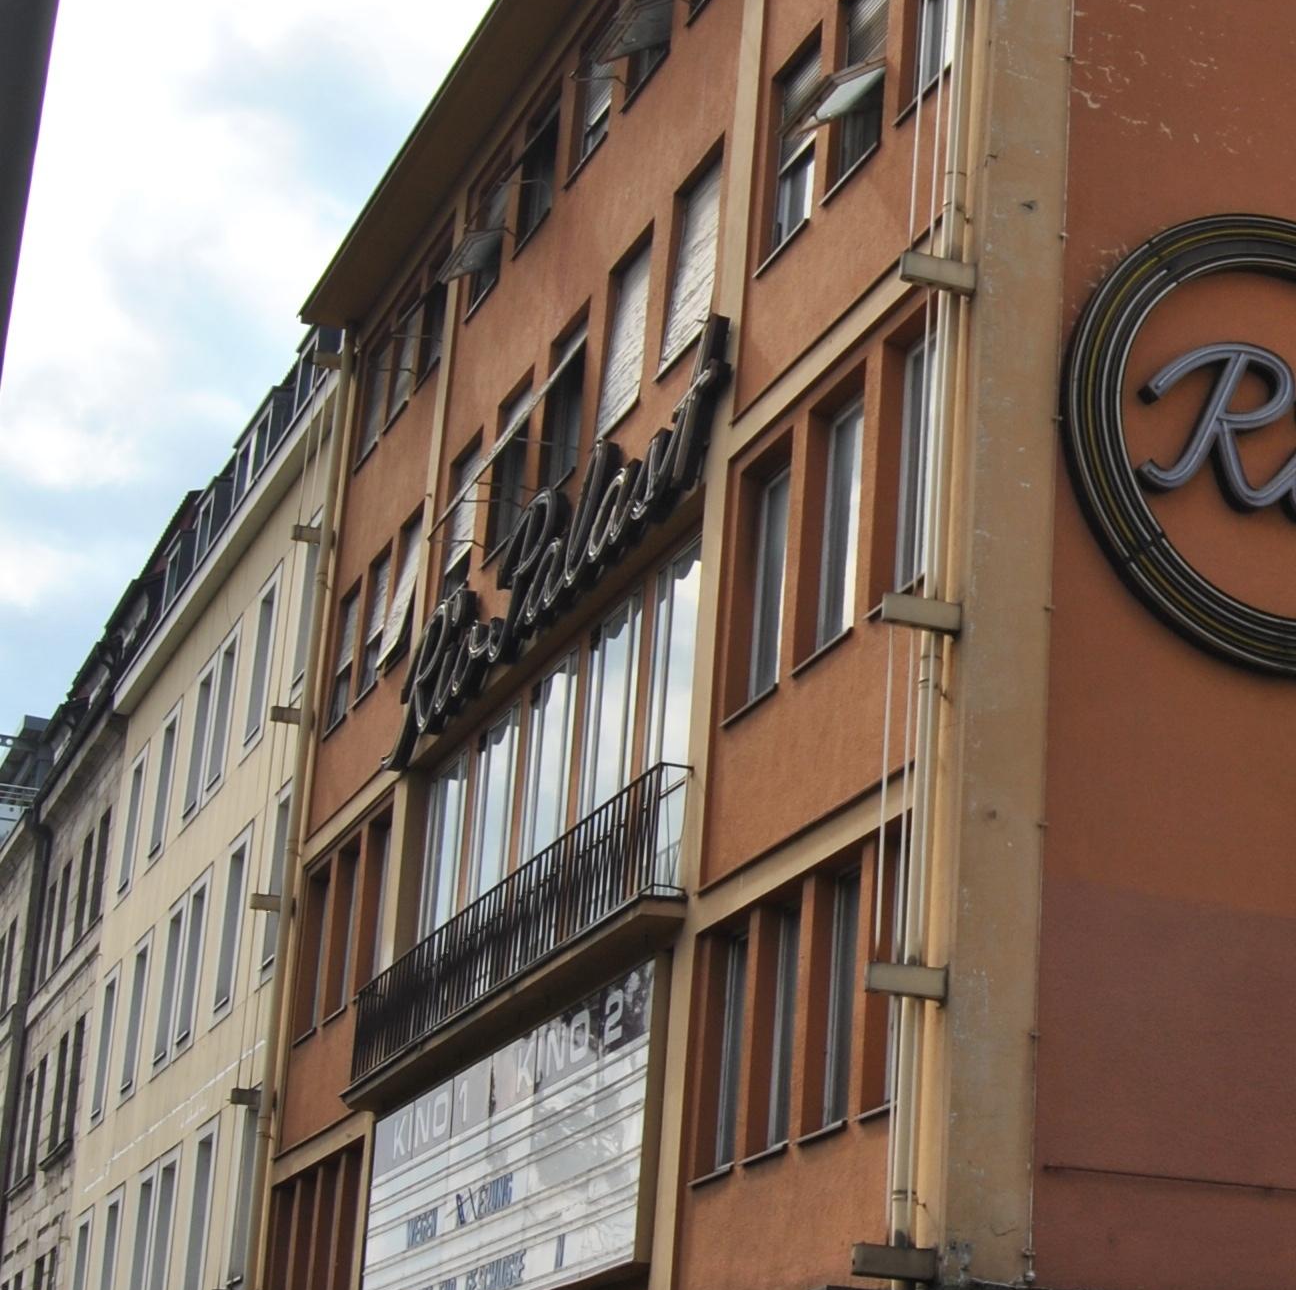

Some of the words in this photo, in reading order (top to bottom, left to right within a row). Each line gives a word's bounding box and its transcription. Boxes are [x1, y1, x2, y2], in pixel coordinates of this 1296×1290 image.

[516, 1008, 591, 1094] KINO
[603, 988, 625, 1047] 2
[393, 1090, 450, 1159] KINO
[459, 1079, 469, 1123] 1
